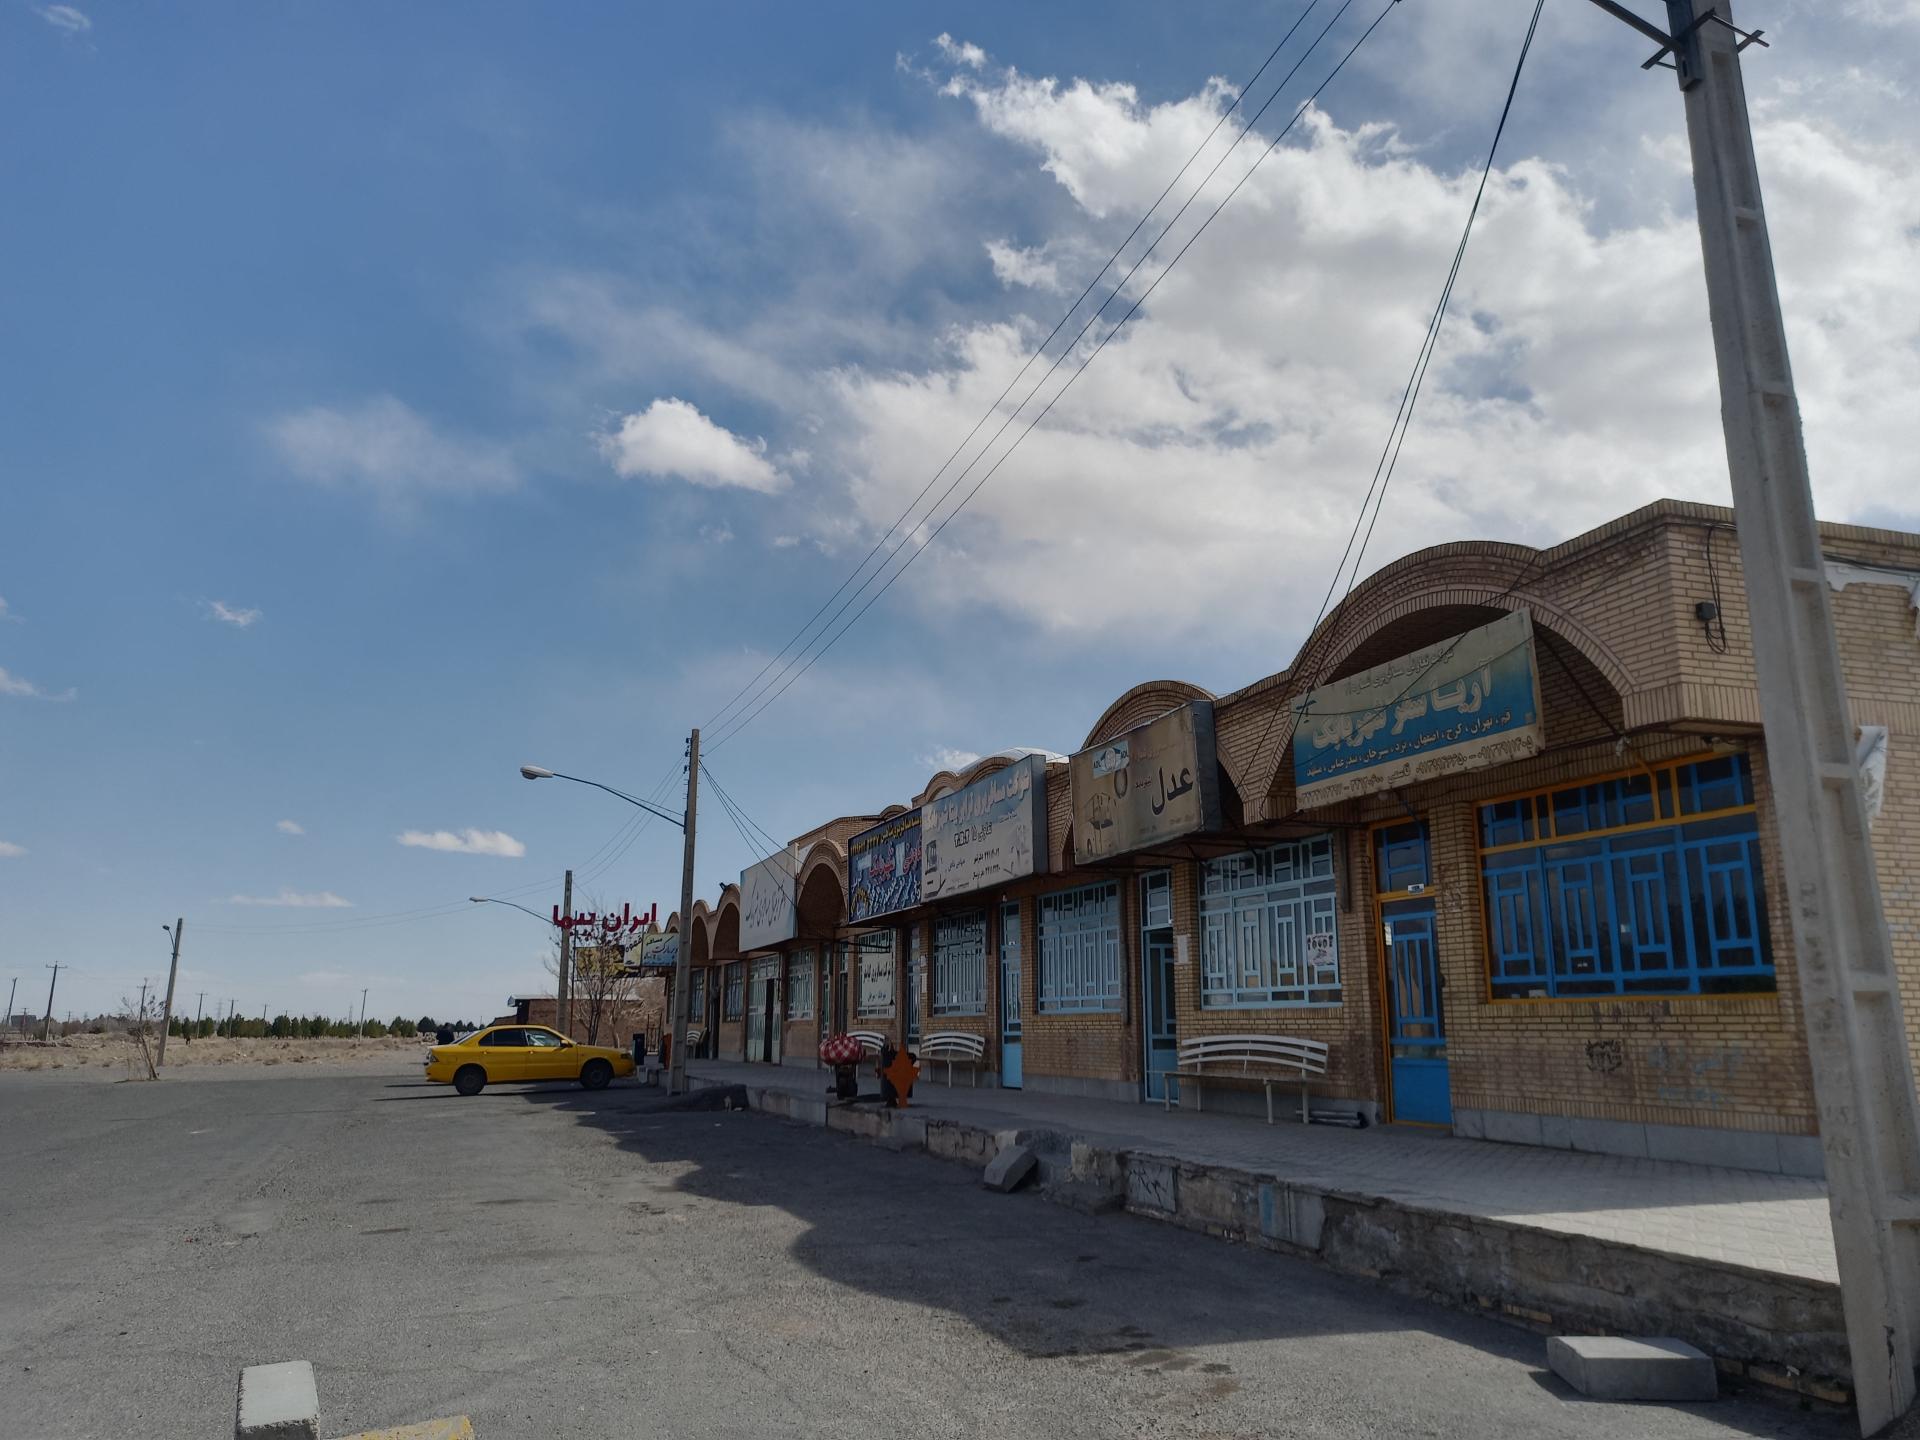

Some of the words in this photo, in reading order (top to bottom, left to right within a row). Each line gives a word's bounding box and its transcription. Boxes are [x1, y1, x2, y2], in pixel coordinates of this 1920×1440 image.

[1431, 657, 1492, 714] آریا
[1151, 767, 1193, 816] عدل
[553, 904, 595, 937] پیما
[602, 903, 657, 933] ایران
